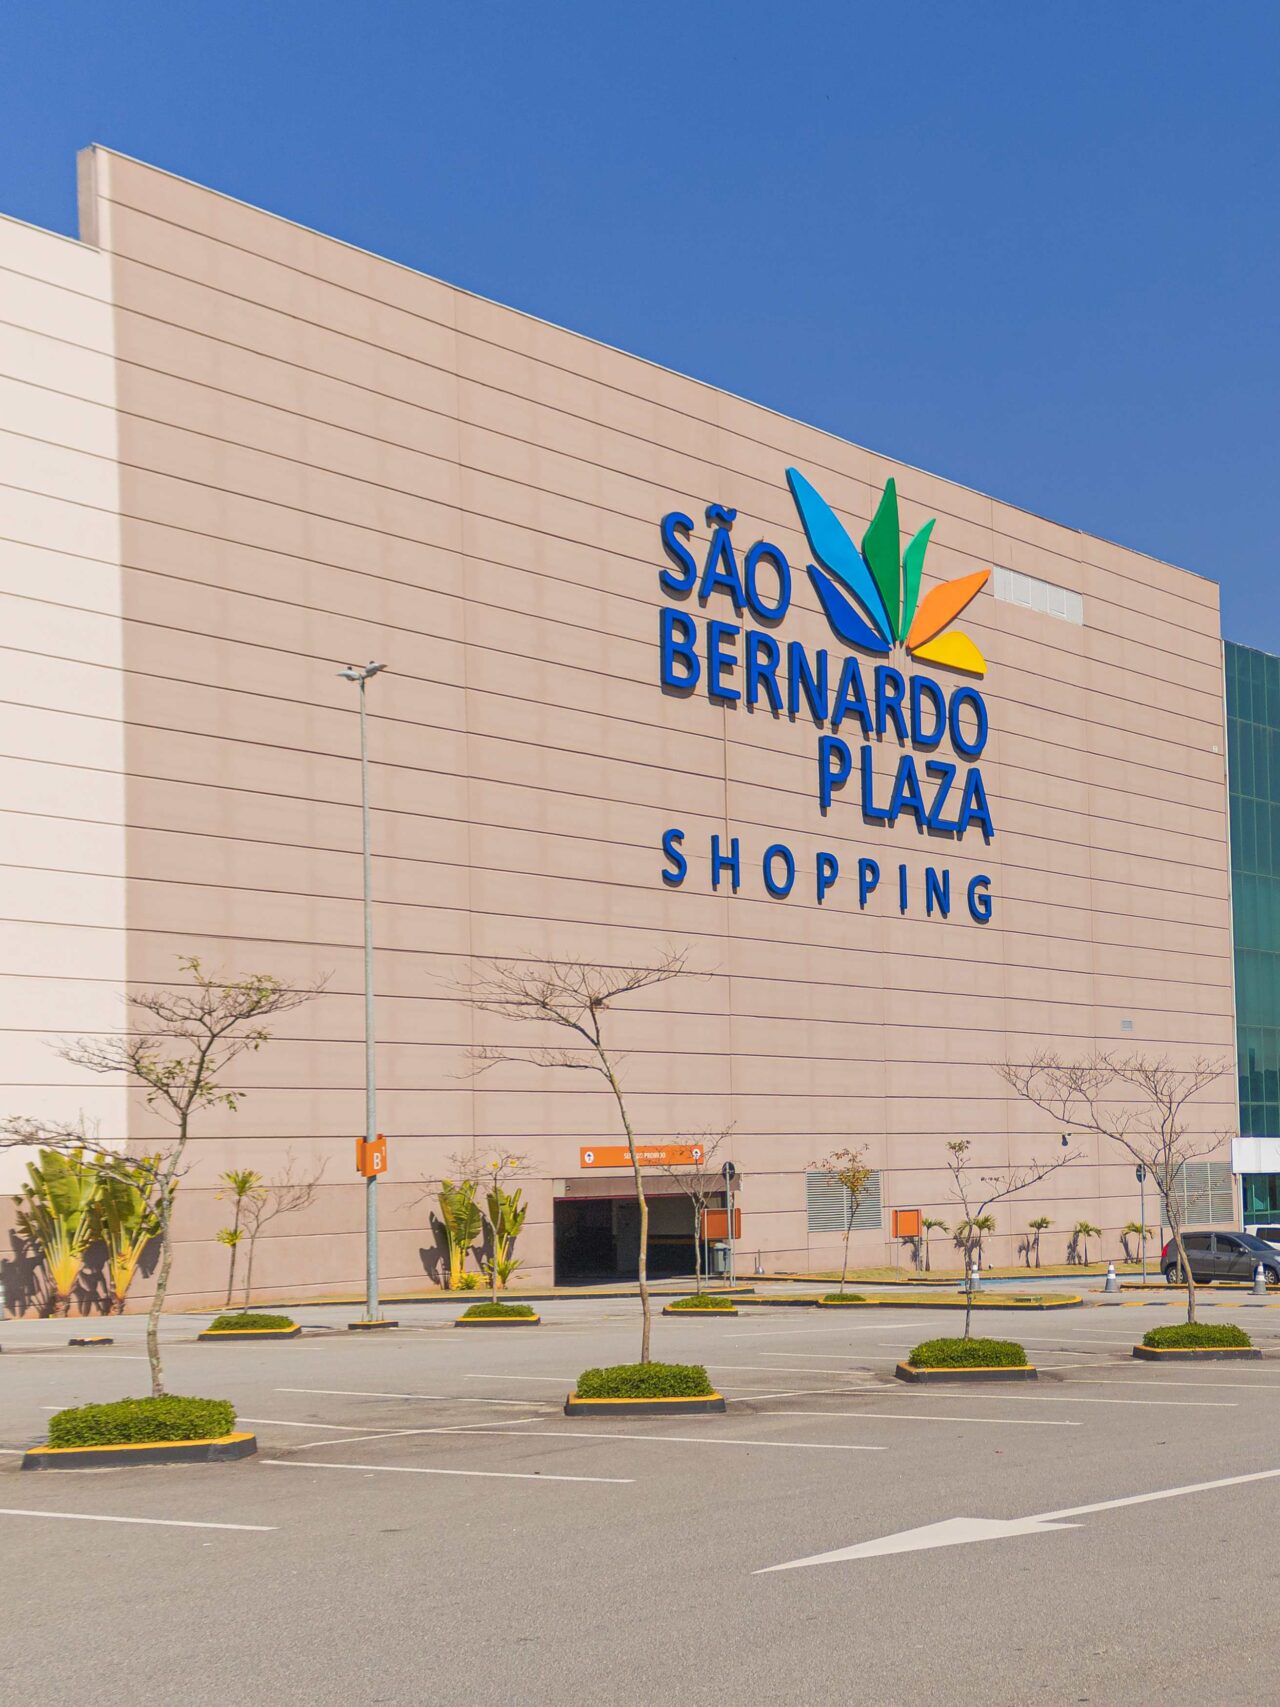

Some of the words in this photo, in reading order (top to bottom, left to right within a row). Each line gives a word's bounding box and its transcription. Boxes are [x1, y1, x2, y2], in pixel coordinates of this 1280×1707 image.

[659, 504, 791, 619] SÃO
[660, 607, 988, 755] BERNARDO
[819, 736, 994, 837] PLAZA
[662, 828, 992, 921] SHOPPING
